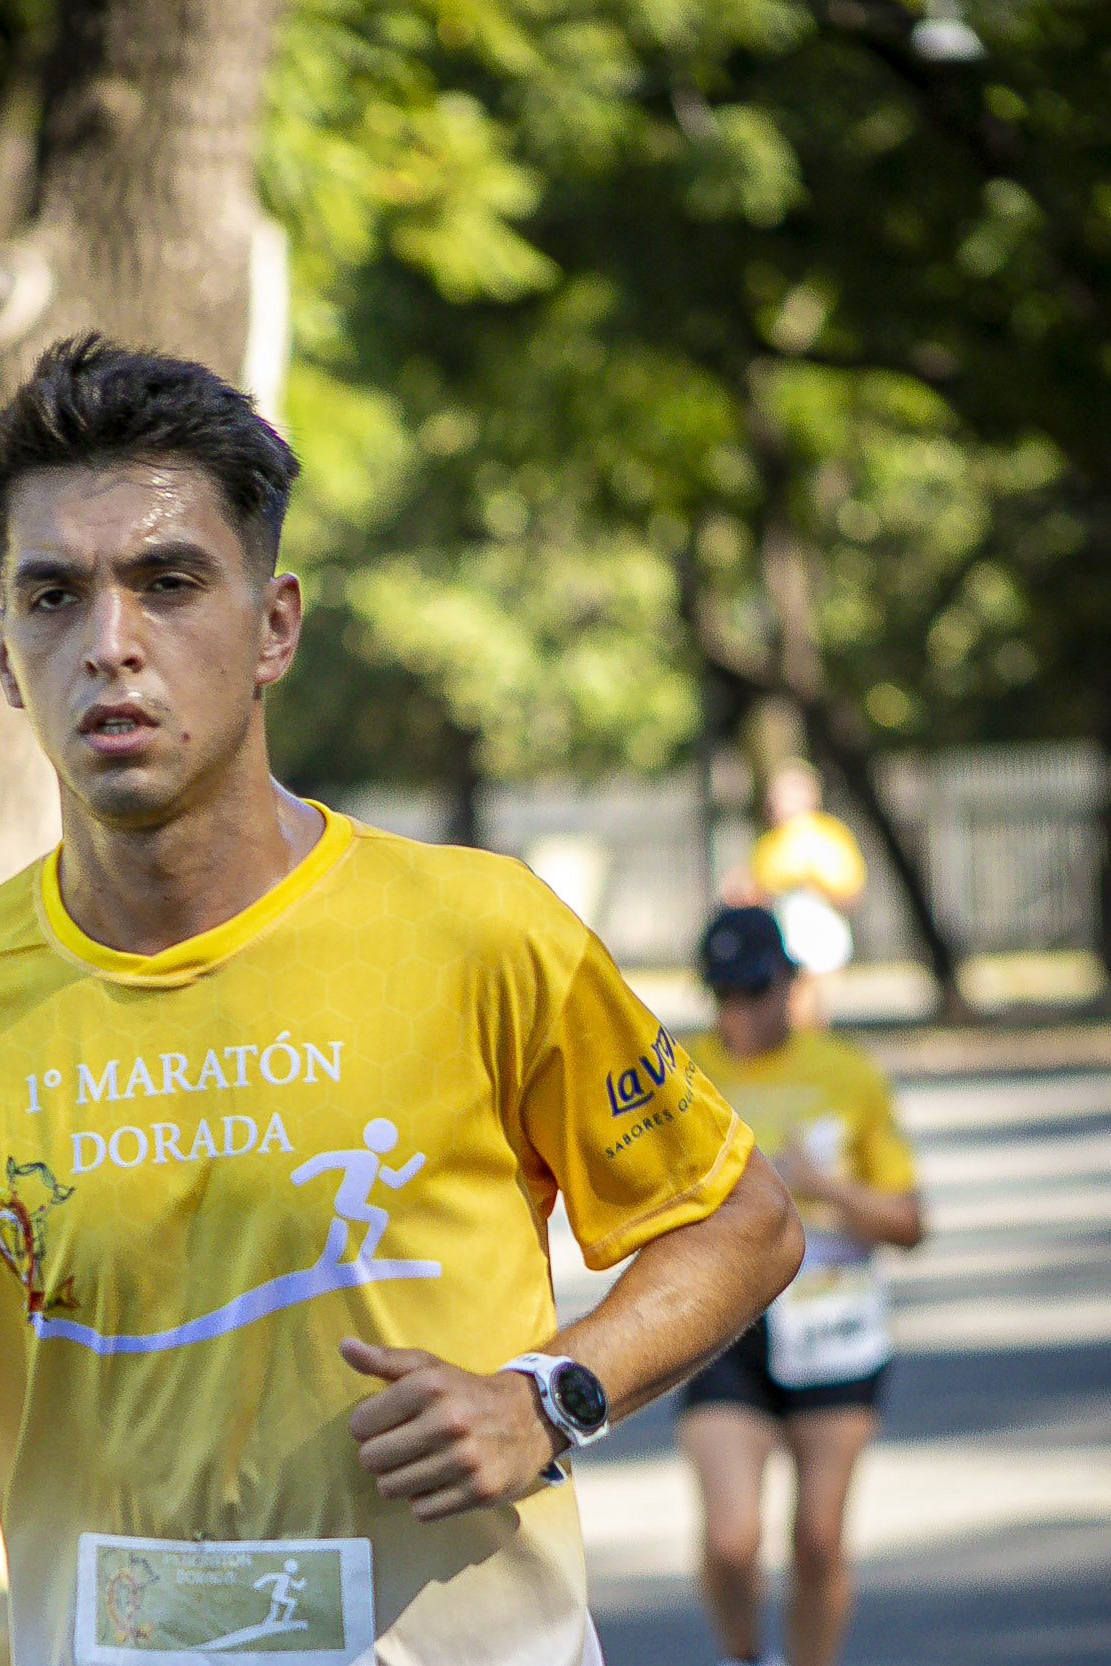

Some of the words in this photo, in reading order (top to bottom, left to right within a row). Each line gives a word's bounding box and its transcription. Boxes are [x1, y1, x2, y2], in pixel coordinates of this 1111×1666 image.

[76, 1030, 344, 1105] MARATÓN
[70, 1111, 295, 1174] DORADA
[605, 1109, 675, 1160] SABORES
